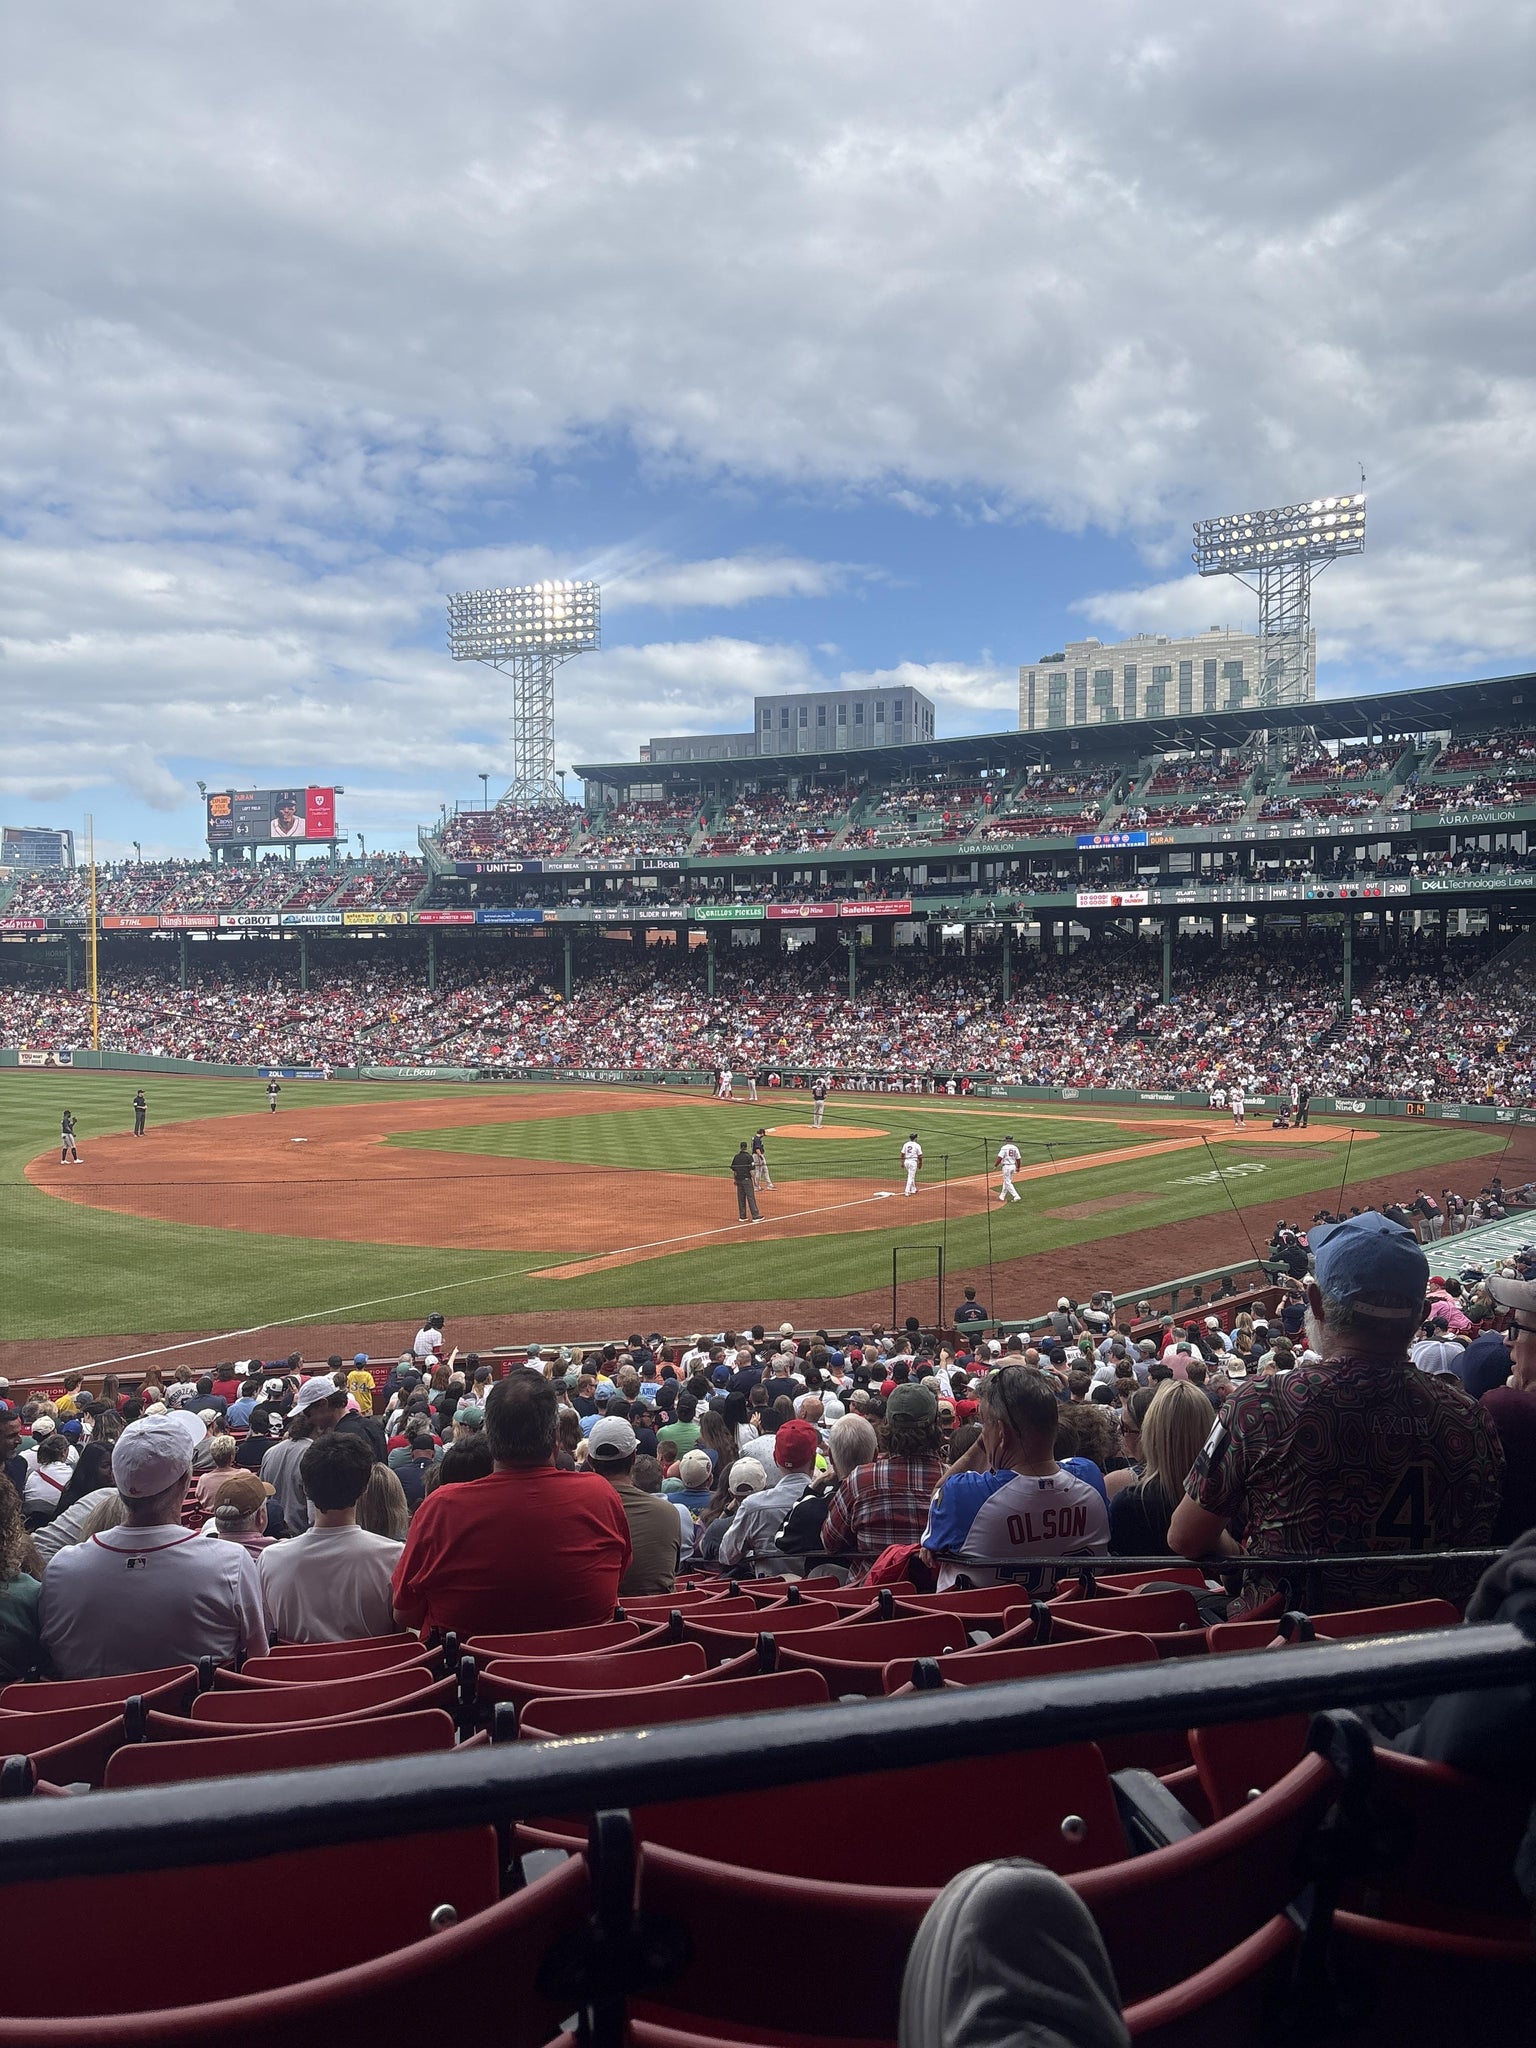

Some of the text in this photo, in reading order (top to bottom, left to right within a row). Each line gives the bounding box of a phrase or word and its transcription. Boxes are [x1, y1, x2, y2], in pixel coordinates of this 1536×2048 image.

[1471, 811, 1516, 822] PAVILION
[982, 843, 1014, 852] PAVILION
[486, 863, 524, 872] UNITED
[642, 860, 680, 869] L.L.Bean
[1448, 879, 1507, 890] Technologies
[1508, 876, 1533, 887] Level
[1389, 884, 1407, 893] 2ND
[669, 910, 683, 918] MPH
[734, 908, 762, 916] PICKLES
[842, 906, 875, 914] Safelite
[119, 918, 142, 926] STIHL
[182, 917, 215, 926] Hawaiian
[301, 915, 340, 923] CALL128.COM
[16, 920, 38, 929] PIZZA
[268, 1070, 285, 1078] ZOLL
[398, 1068, 437, 1077] L.L.Bean
[1140, 1093, 1176, 1101] smartwater
[907, 1146, 913, 1154] 2
[351, 1382, 367, 1392] 34
[1369, 1413, 1430, 1437] AXON
[1370, 1461, 1436, 1552] 4
[1006, 1505, 1088, 1545] OLSON
